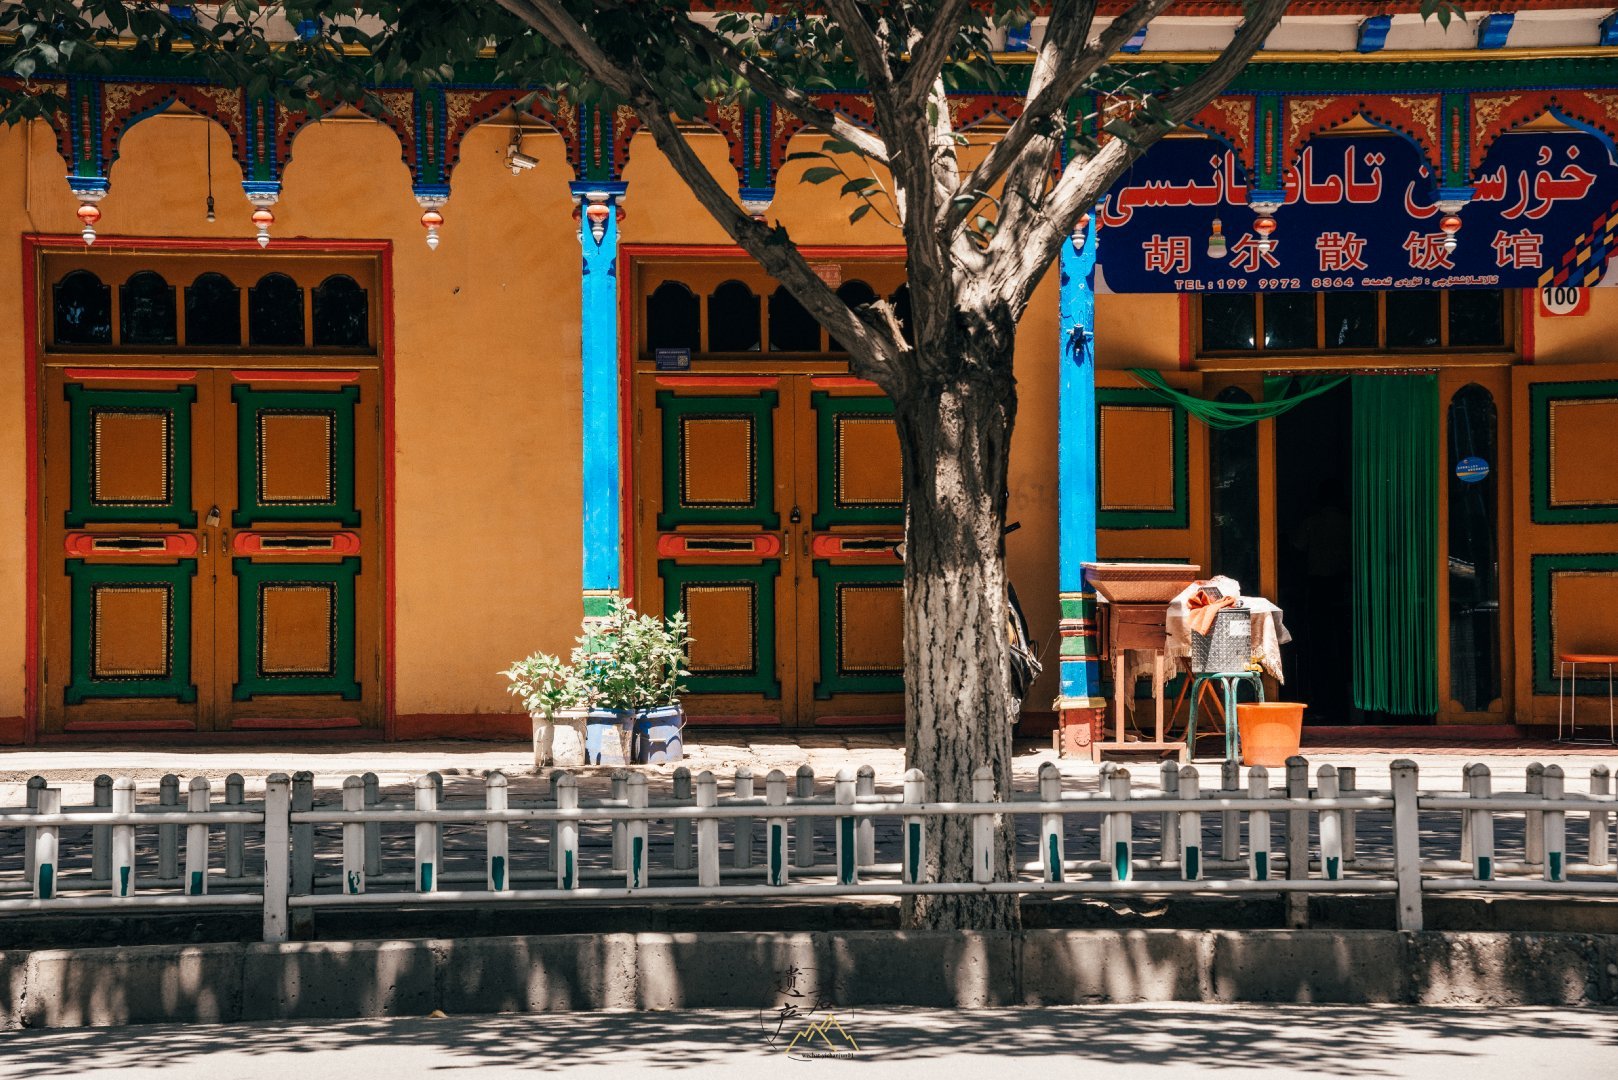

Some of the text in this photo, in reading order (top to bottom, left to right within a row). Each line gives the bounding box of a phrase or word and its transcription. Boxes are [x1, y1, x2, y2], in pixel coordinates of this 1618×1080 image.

[1405, 145, 1598, 220] خۇرسن
[1142, 229, 1544, 274] 胡尔散饭馆
[1258, 278, 1301, 289] 9972
[1311, 277, 1355, 289] 8364
[1544, 287, 1578, 306] 100
